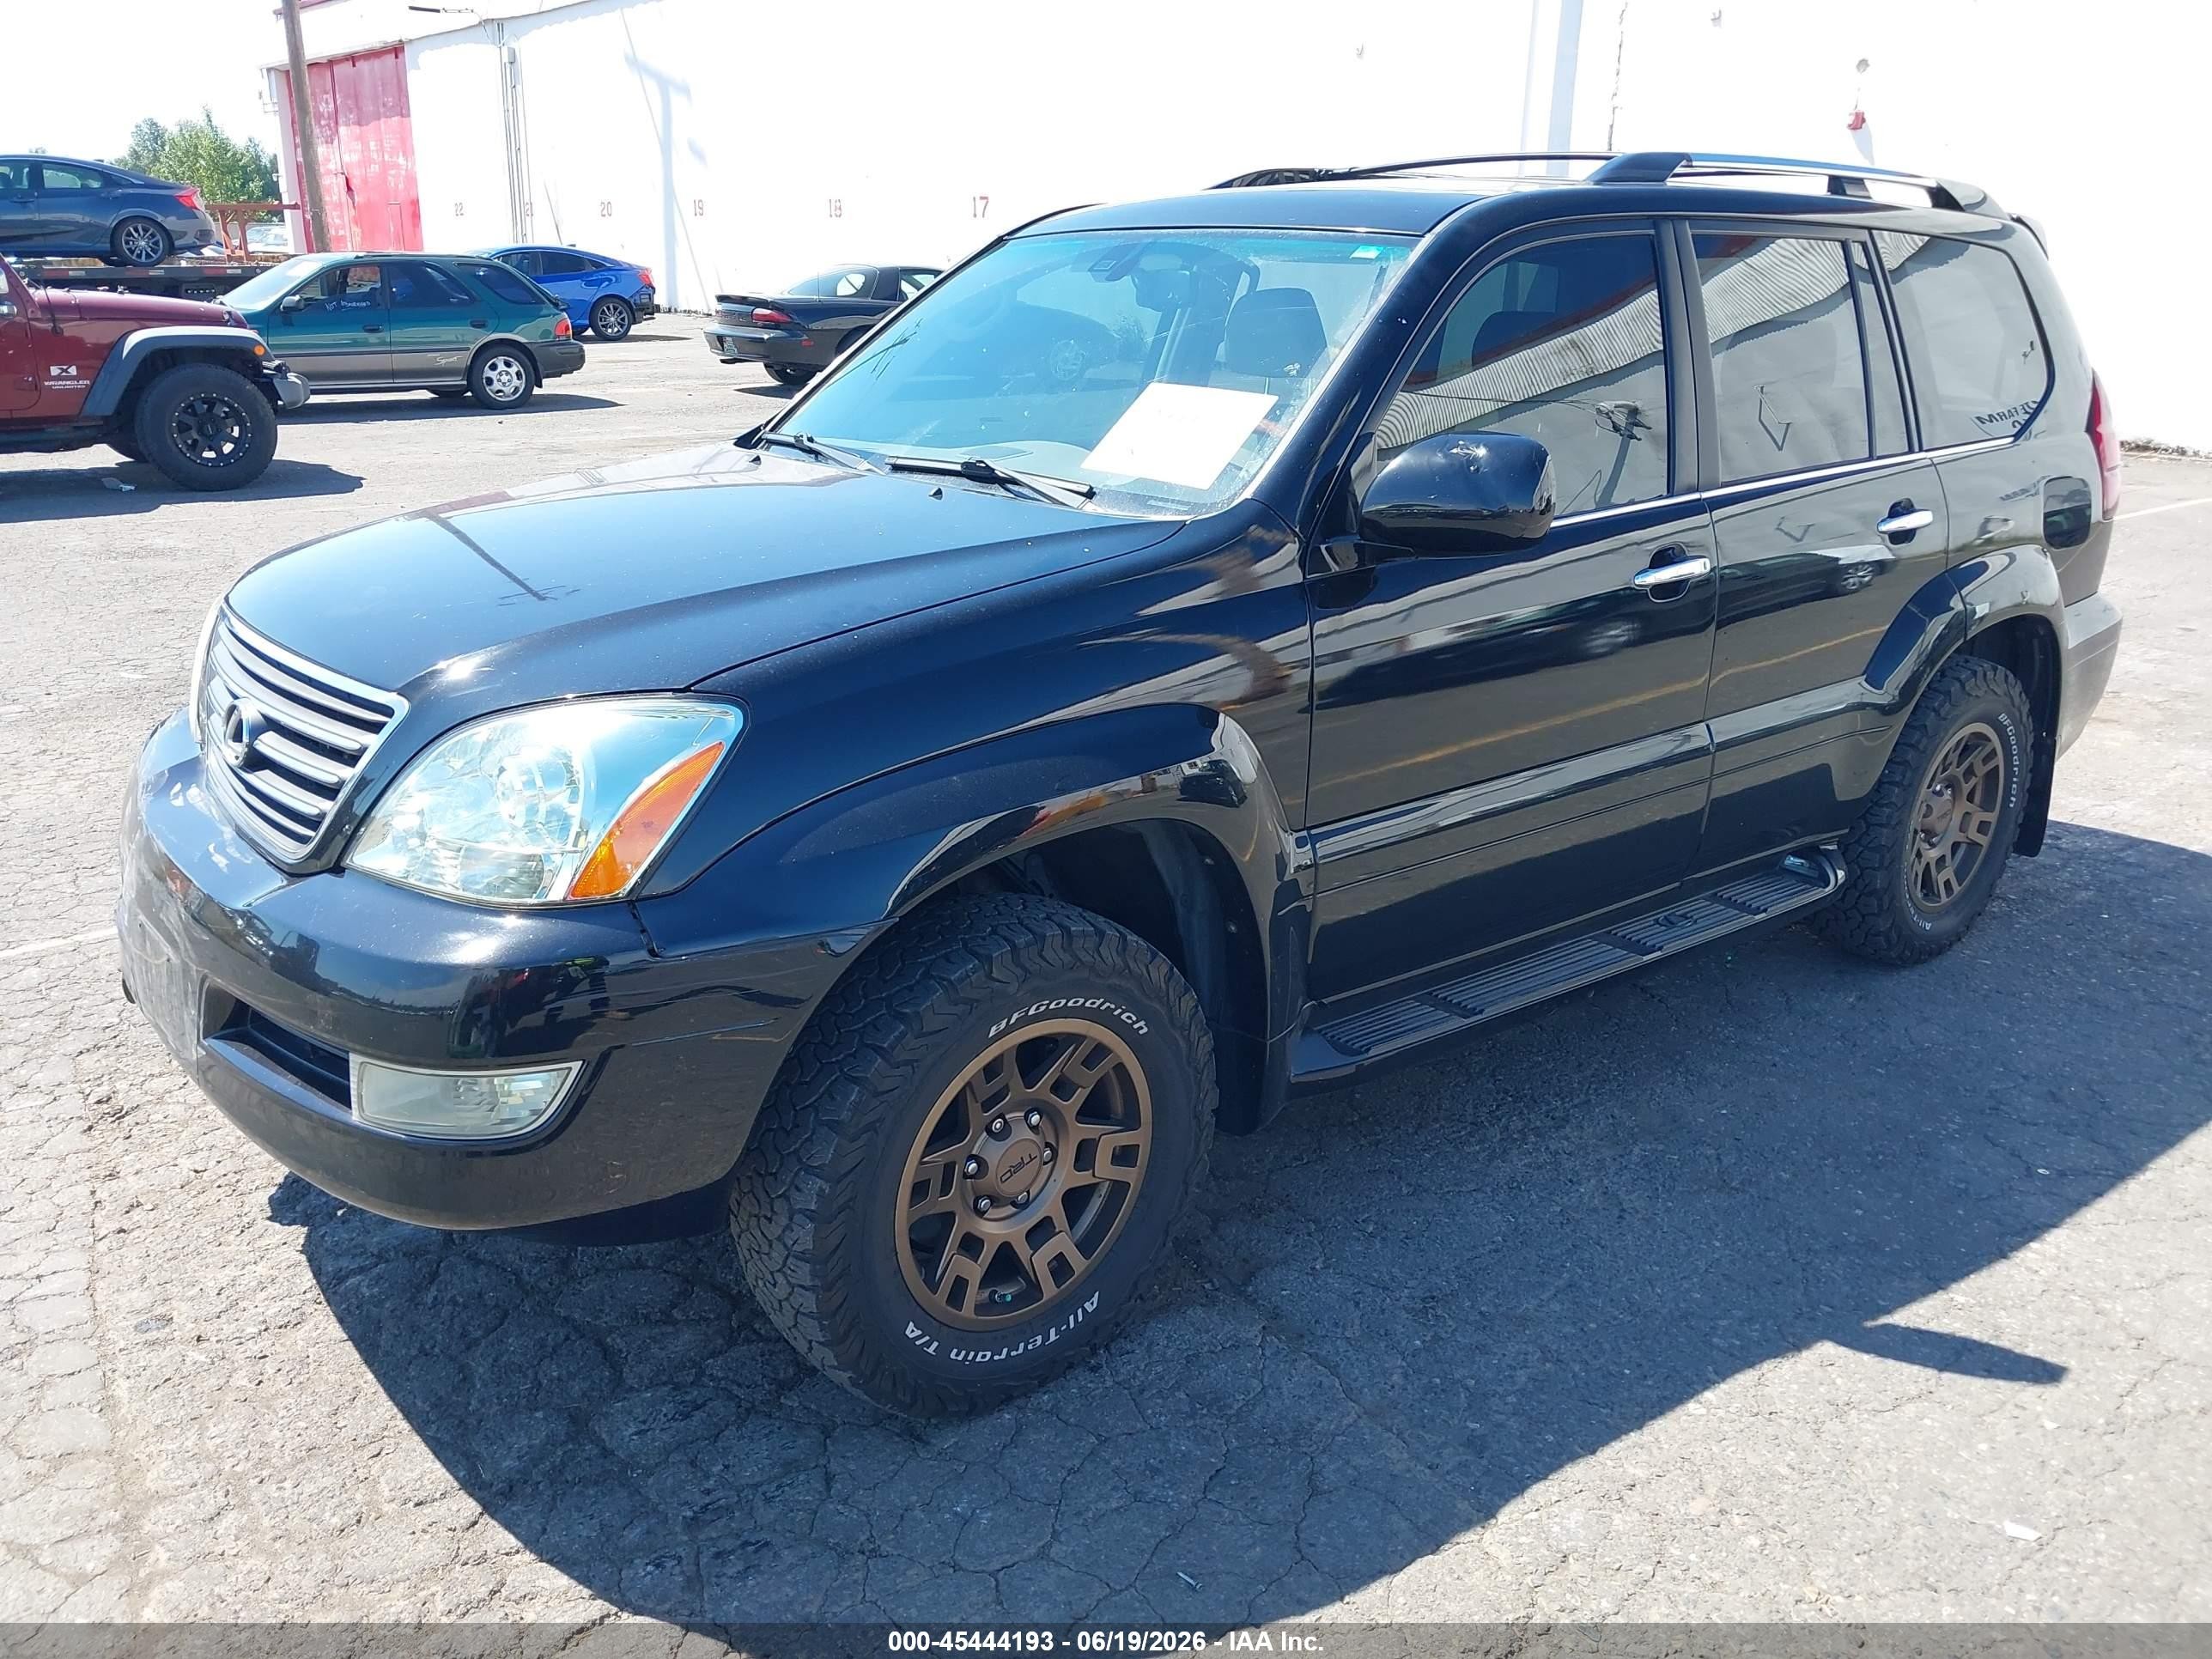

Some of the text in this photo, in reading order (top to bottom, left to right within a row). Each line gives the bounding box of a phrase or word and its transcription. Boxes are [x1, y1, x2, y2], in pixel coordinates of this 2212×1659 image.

[454, 202, 464, 216] 22
[600, 201, 612, 217] 20
[694, 198, 704, 216] 19
[972, 196, 989, 218] 17
[988, 997, 1149, 1038] BFGoodrich
[1000, 1153, 1038, 1184] TRD
[904, 1291, 1099, 1365] All-Terrain T/A
